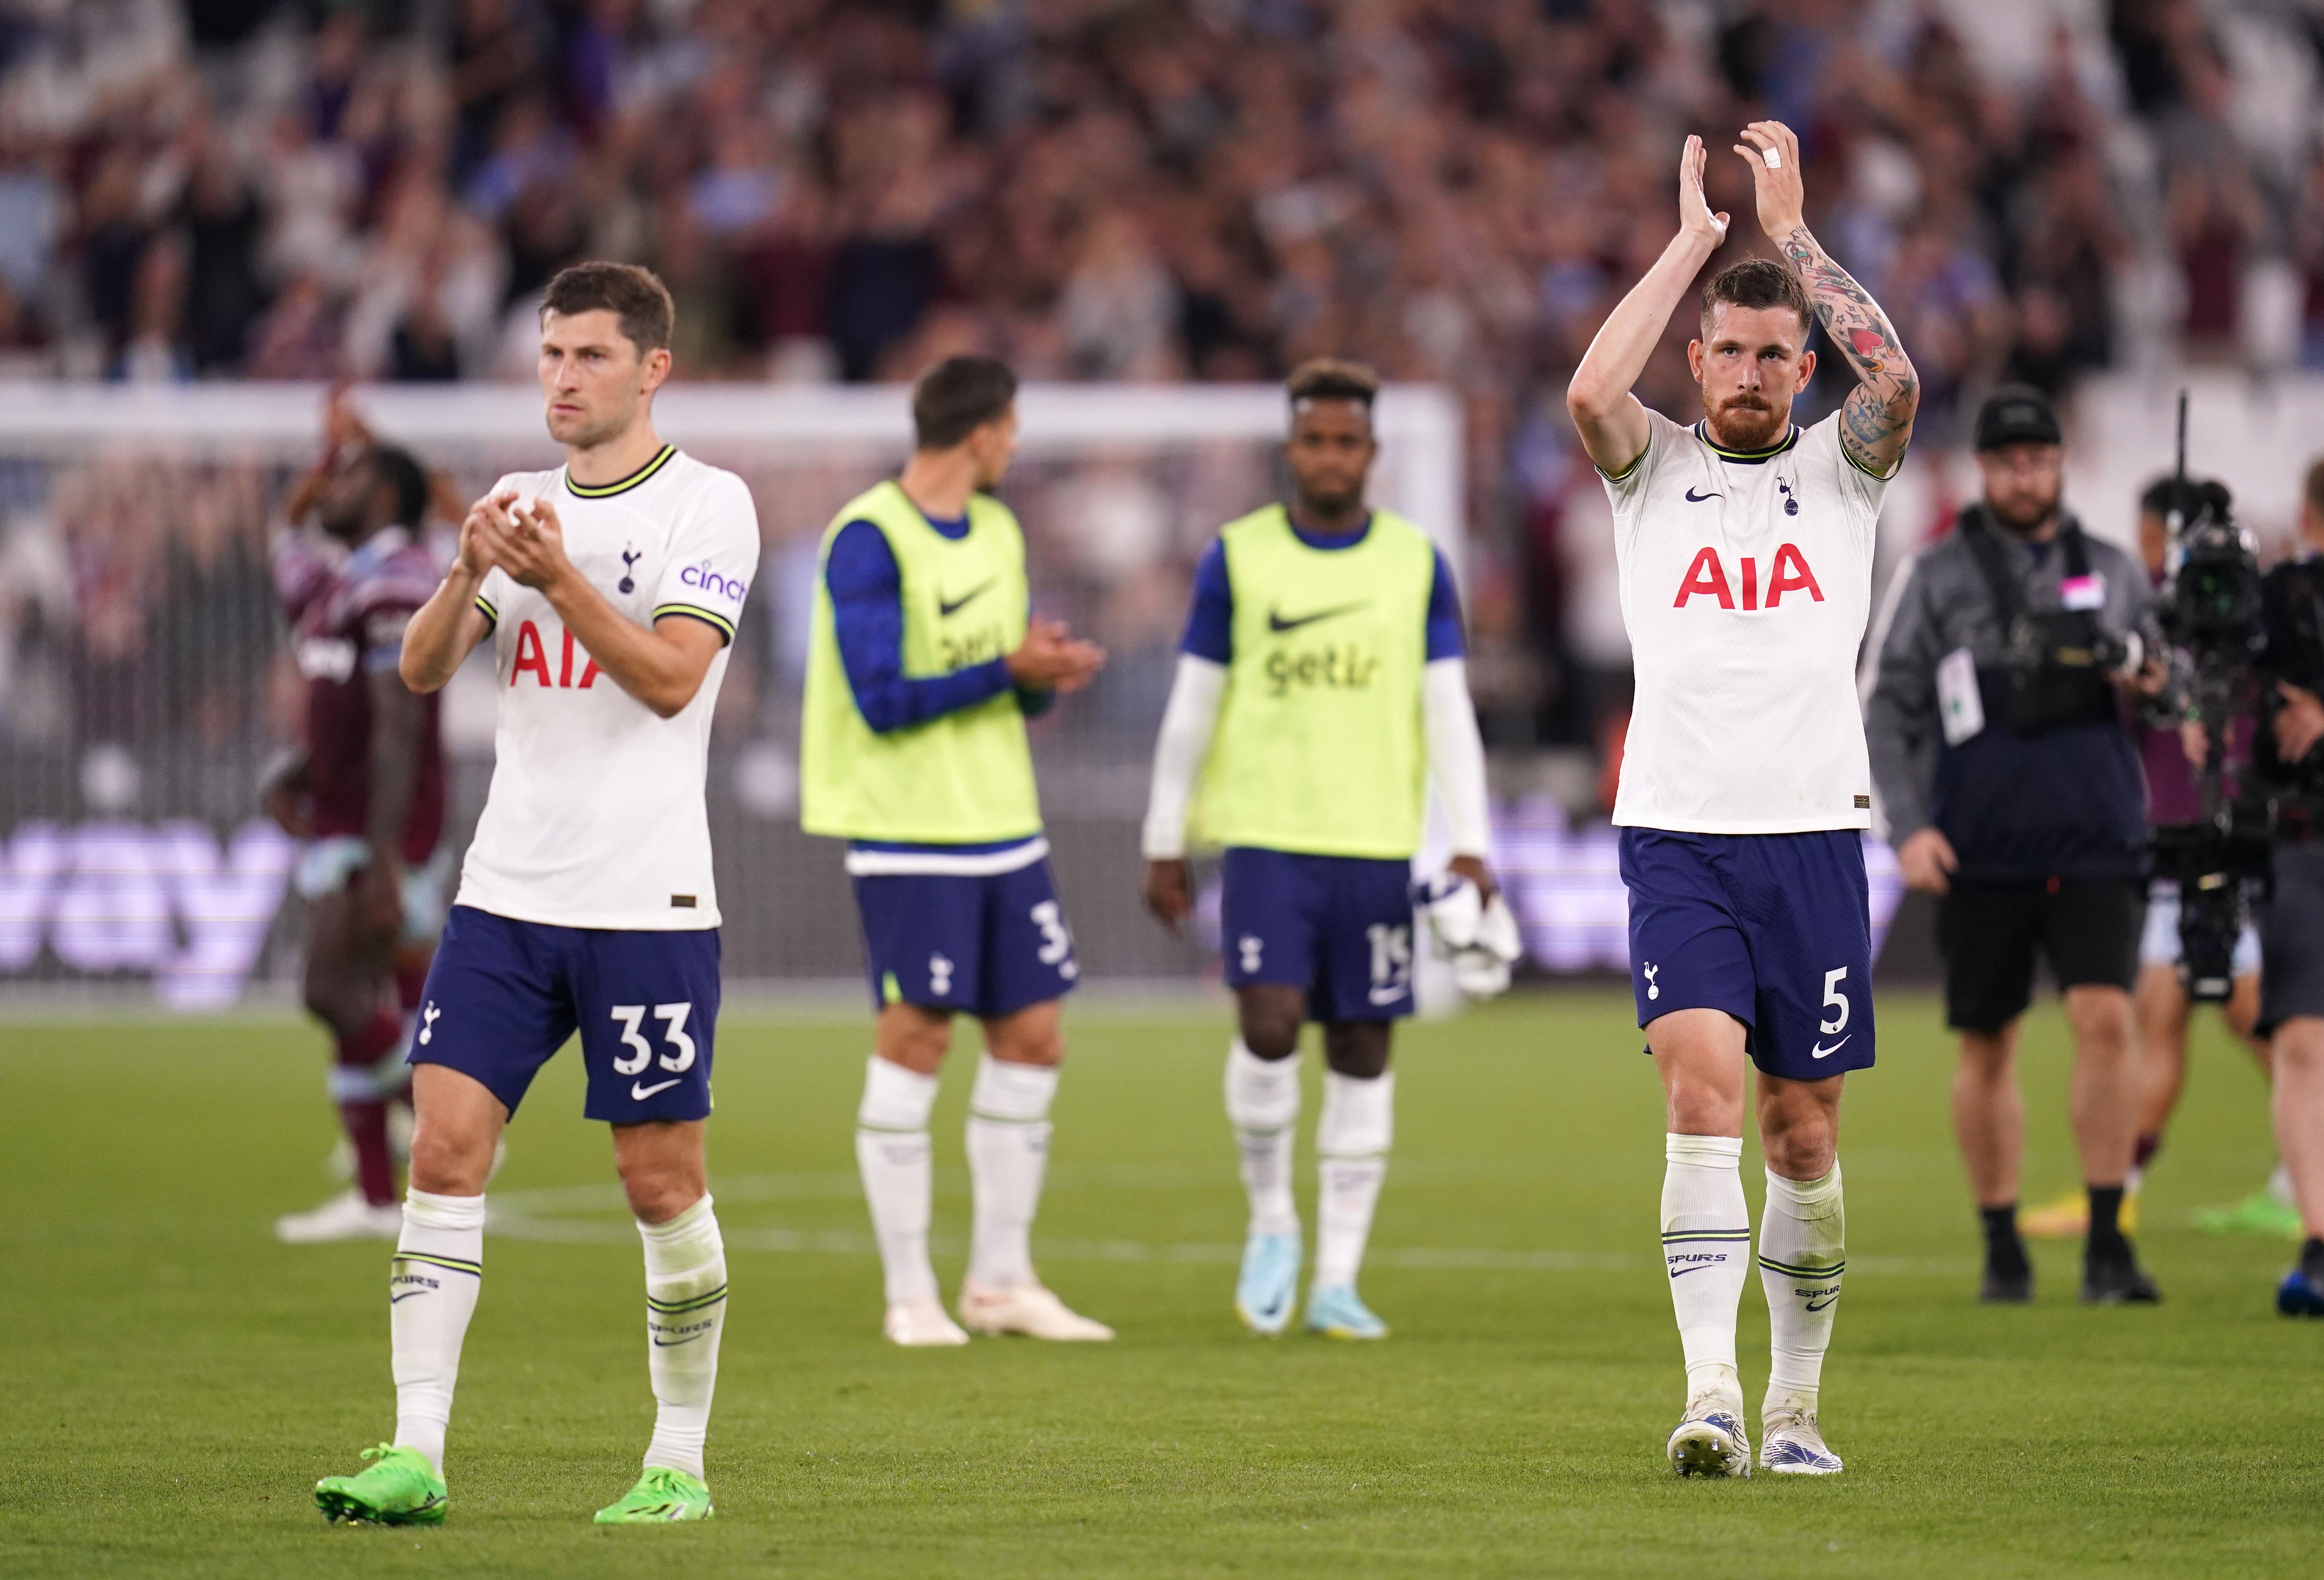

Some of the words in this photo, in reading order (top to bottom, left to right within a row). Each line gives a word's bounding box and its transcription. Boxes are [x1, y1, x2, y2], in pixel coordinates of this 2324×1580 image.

[1673, 543, 1825, 611] AIA
[510, 620, 604, 689] AI
[1264, 644, 1383, 698] getir
[1030, 899, 1073, 966] 3
[1366, 923, 1412, 981] 19
[1820, 966, 1850, 1035] 5
[610, 1001, 696, 1076] 33
[391, 1275, 440, 1290] PURS
[1667, 1254, 1727, 1265] SPURS
[1795, 1285, 1840, 1298] SPUR
[648, 1318, 713, 1334] SPURS
